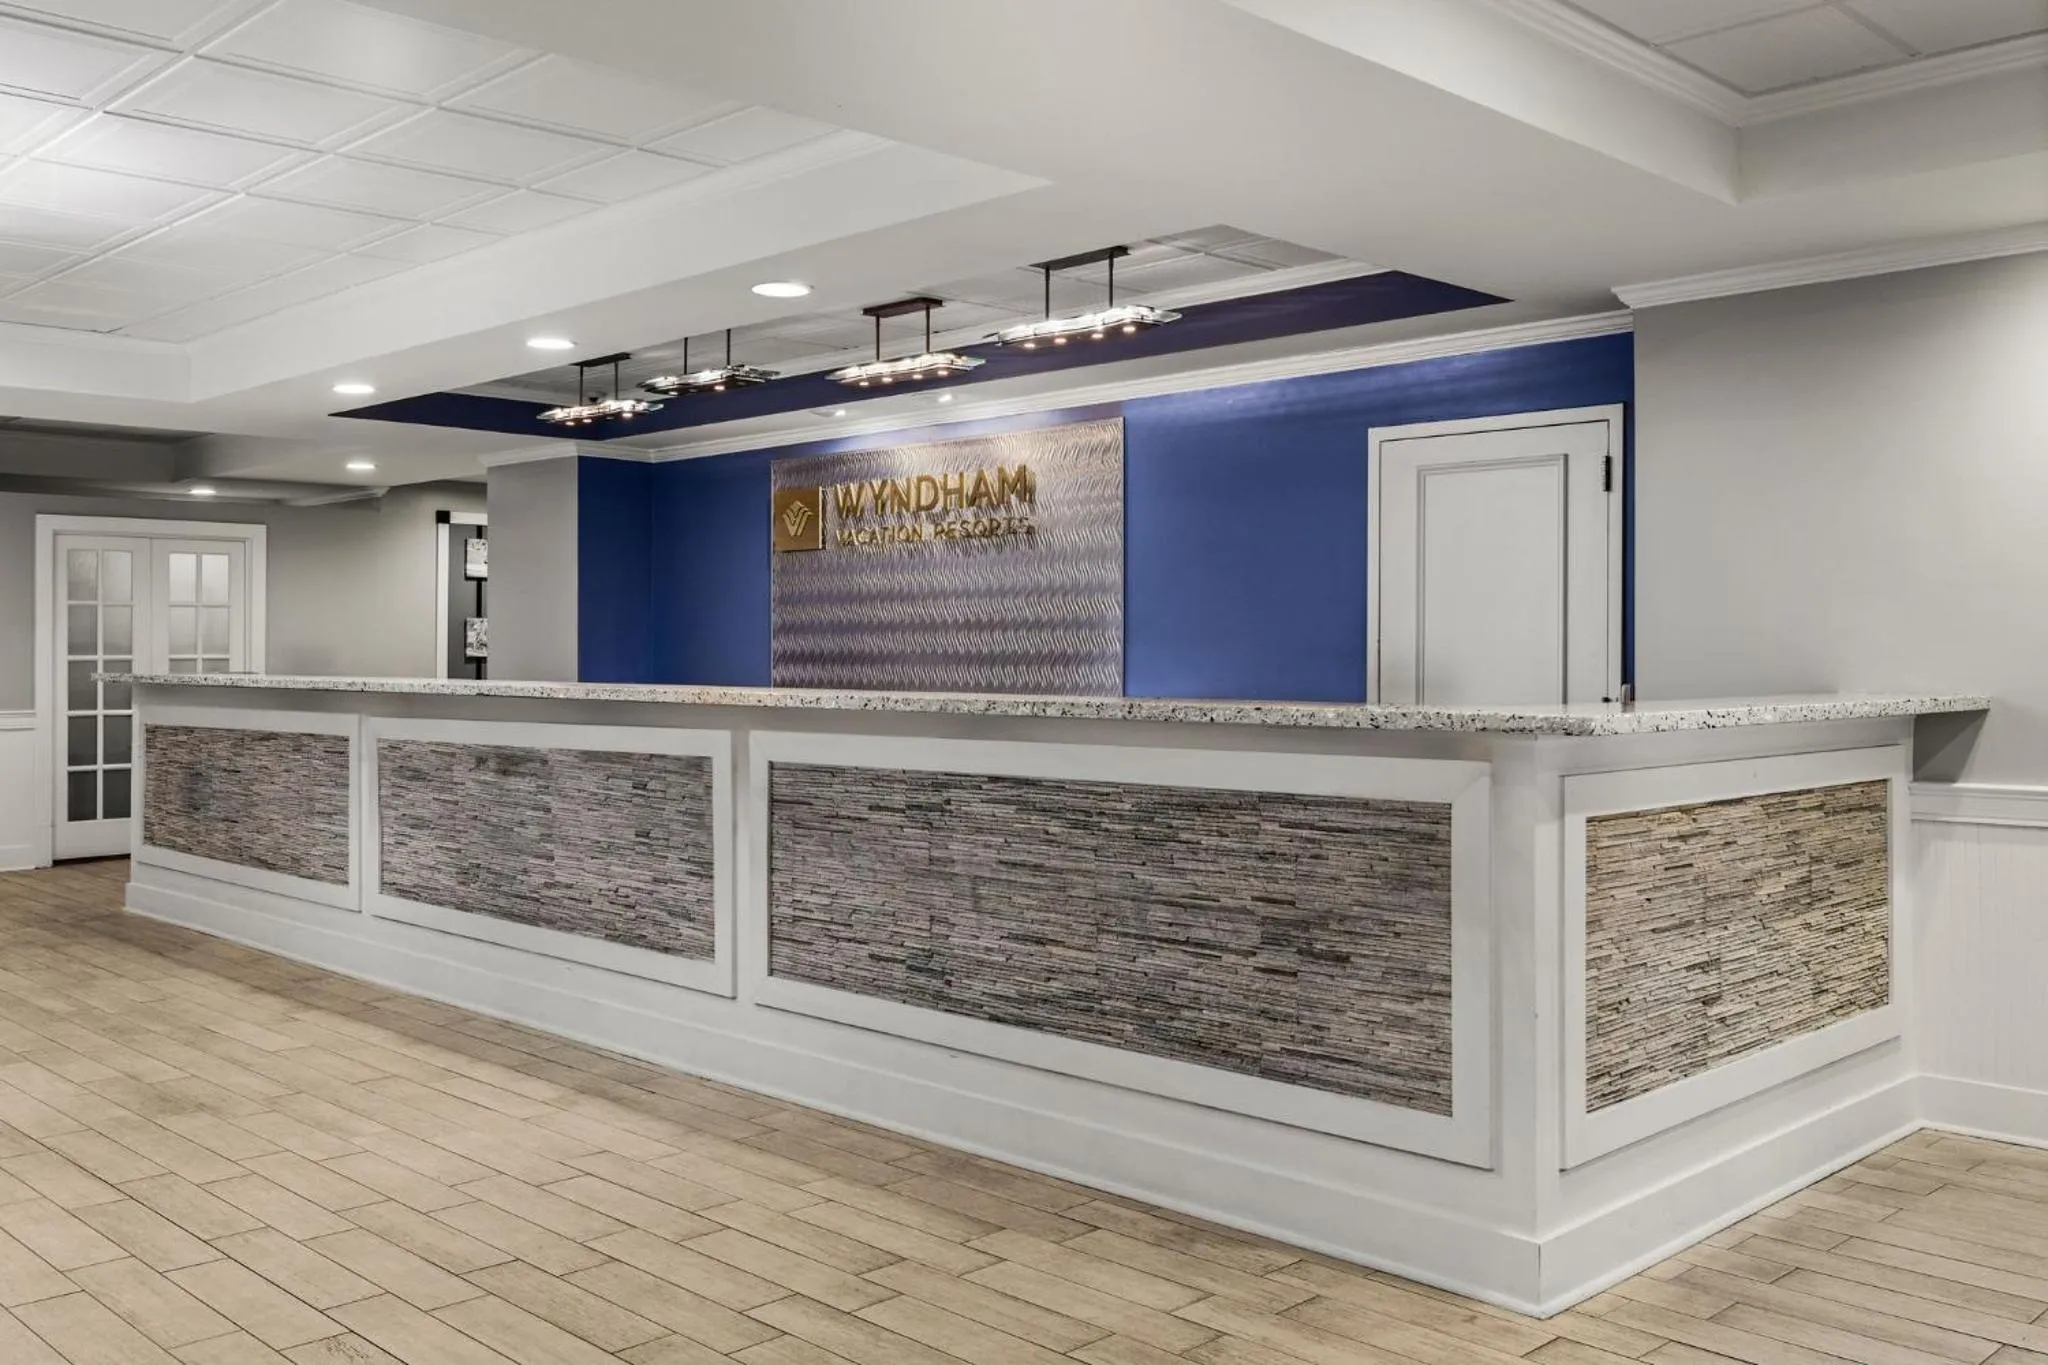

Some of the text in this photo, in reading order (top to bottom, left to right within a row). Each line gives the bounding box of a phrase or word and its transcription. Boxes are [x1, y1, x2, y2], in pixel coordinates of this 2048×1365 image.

[836, 464, 1032, 517] WYNDHAM
[837, 517, 1034, 546] VACATION RESORTS
